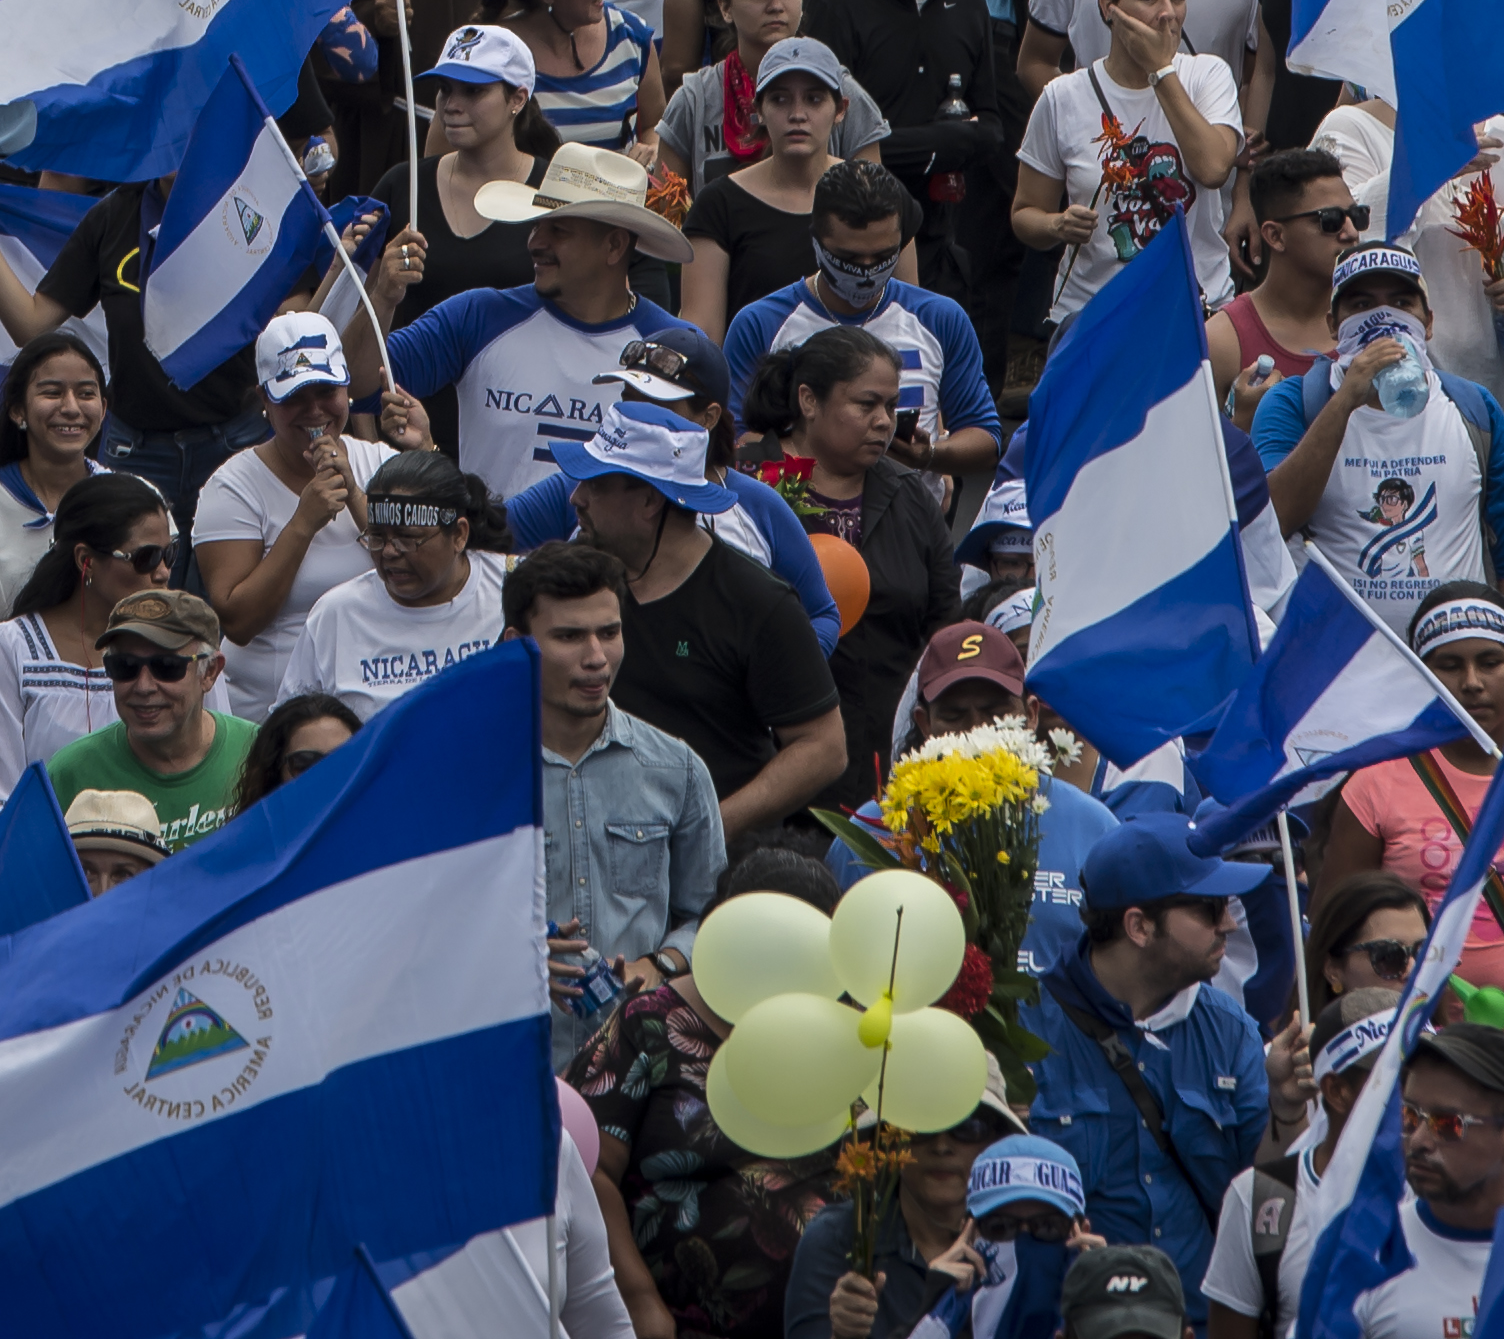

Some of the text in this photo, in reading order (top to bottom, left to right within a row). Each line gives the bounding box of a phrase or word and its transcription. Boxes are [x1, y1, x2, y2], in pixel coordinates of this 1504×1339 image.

[1344, 457, 1362, 468] ME
[1362, 456, 1381, 469] FUI
[1389, 454, 1448, 469] DEFENDER
[1370, 466, 1422, 478] MI PATRIA
[375, 497, 440, 527] NIÑOS CAIDOS
[1369, 578, 1387, 589] NO
[1390, 577, 1441, 589] REGRESO
[1368, 589, 1415, 602] FUI CON
[957, 635, 984, 661] S
[1106, 1275, 1149, 1294] NY
